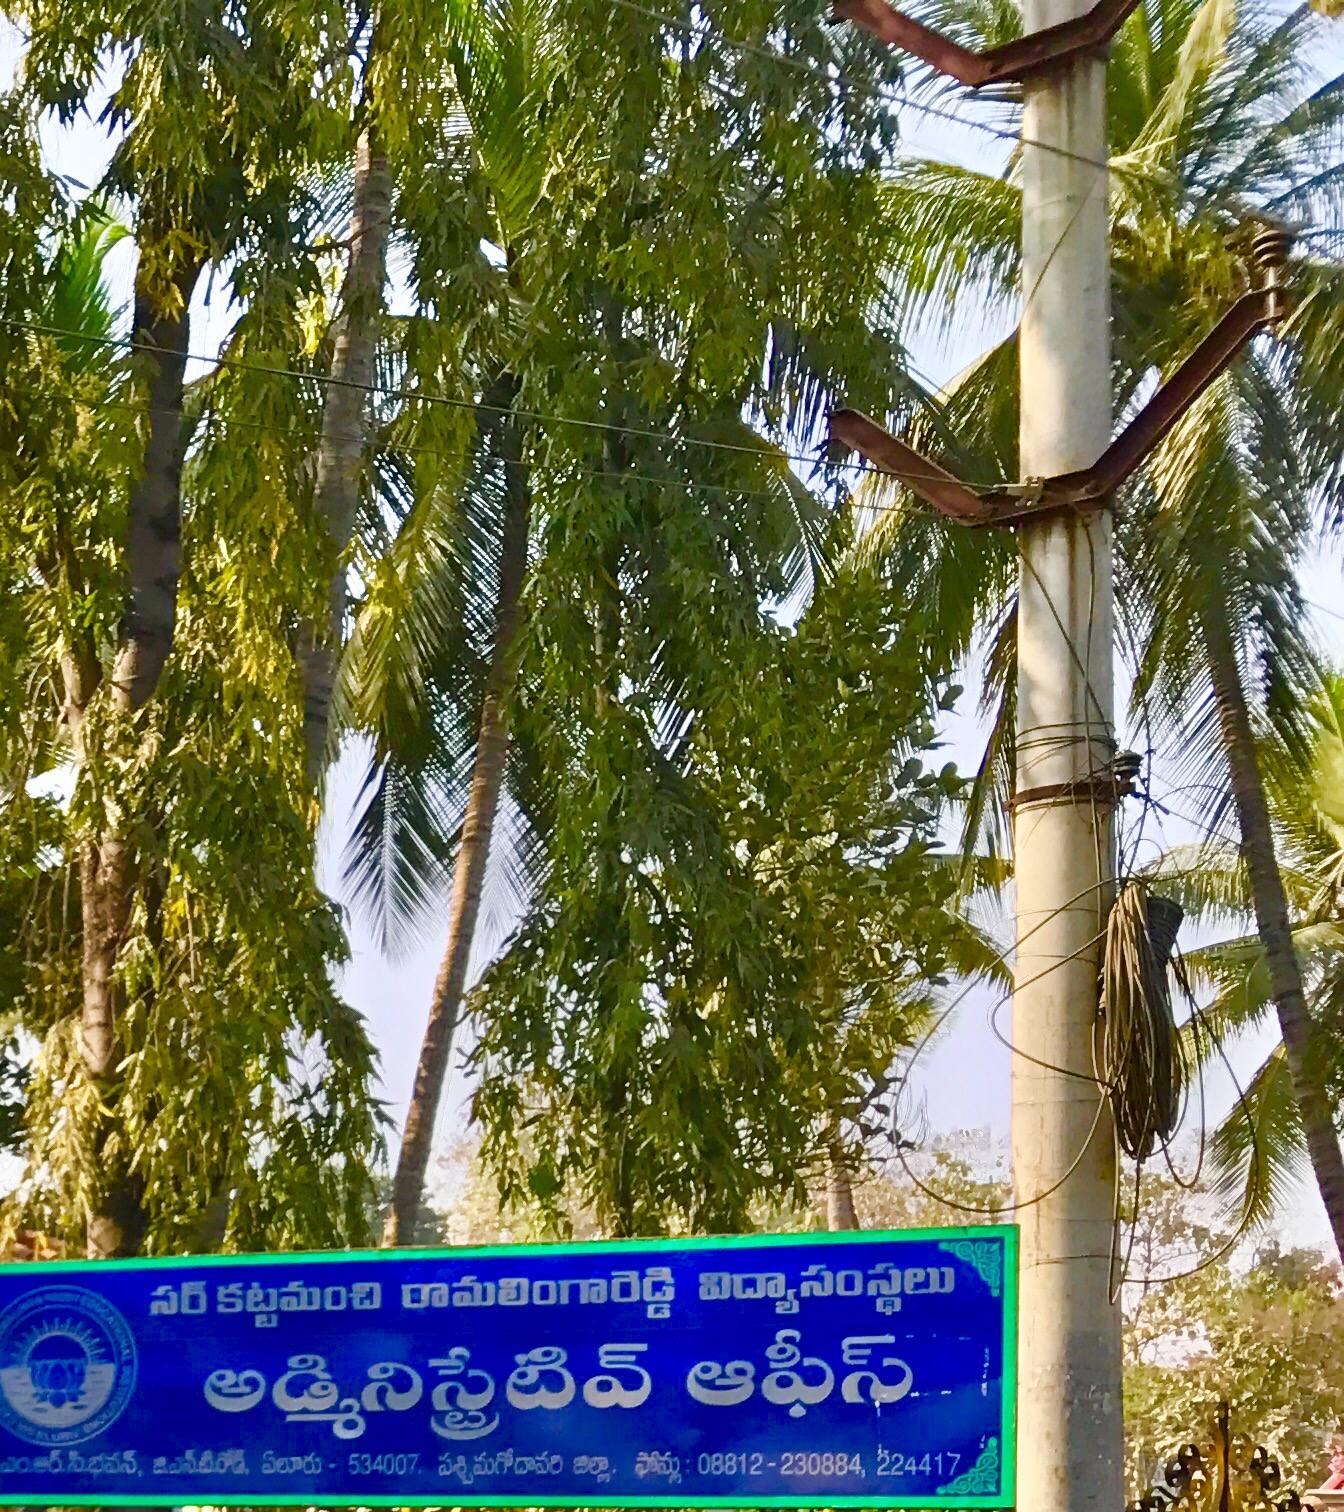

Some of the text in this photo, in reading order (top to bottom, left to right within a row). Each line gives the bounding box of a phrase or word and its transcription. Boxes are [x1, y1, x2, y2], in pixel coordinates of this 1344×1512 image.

[150, 1281, 207, 1315] సర్
[216, 1280, 381, 1327] కట్టమంచి
[401, 1267, 675, 1319] రామలింగారెడ్డి
[204, 1343, 652, 1440] అడ్మినిస్ట్రేటివ్
[686, 1329, 913, 1418] ఆఫీస్
[877, 1452, 961, 1476] 224417
